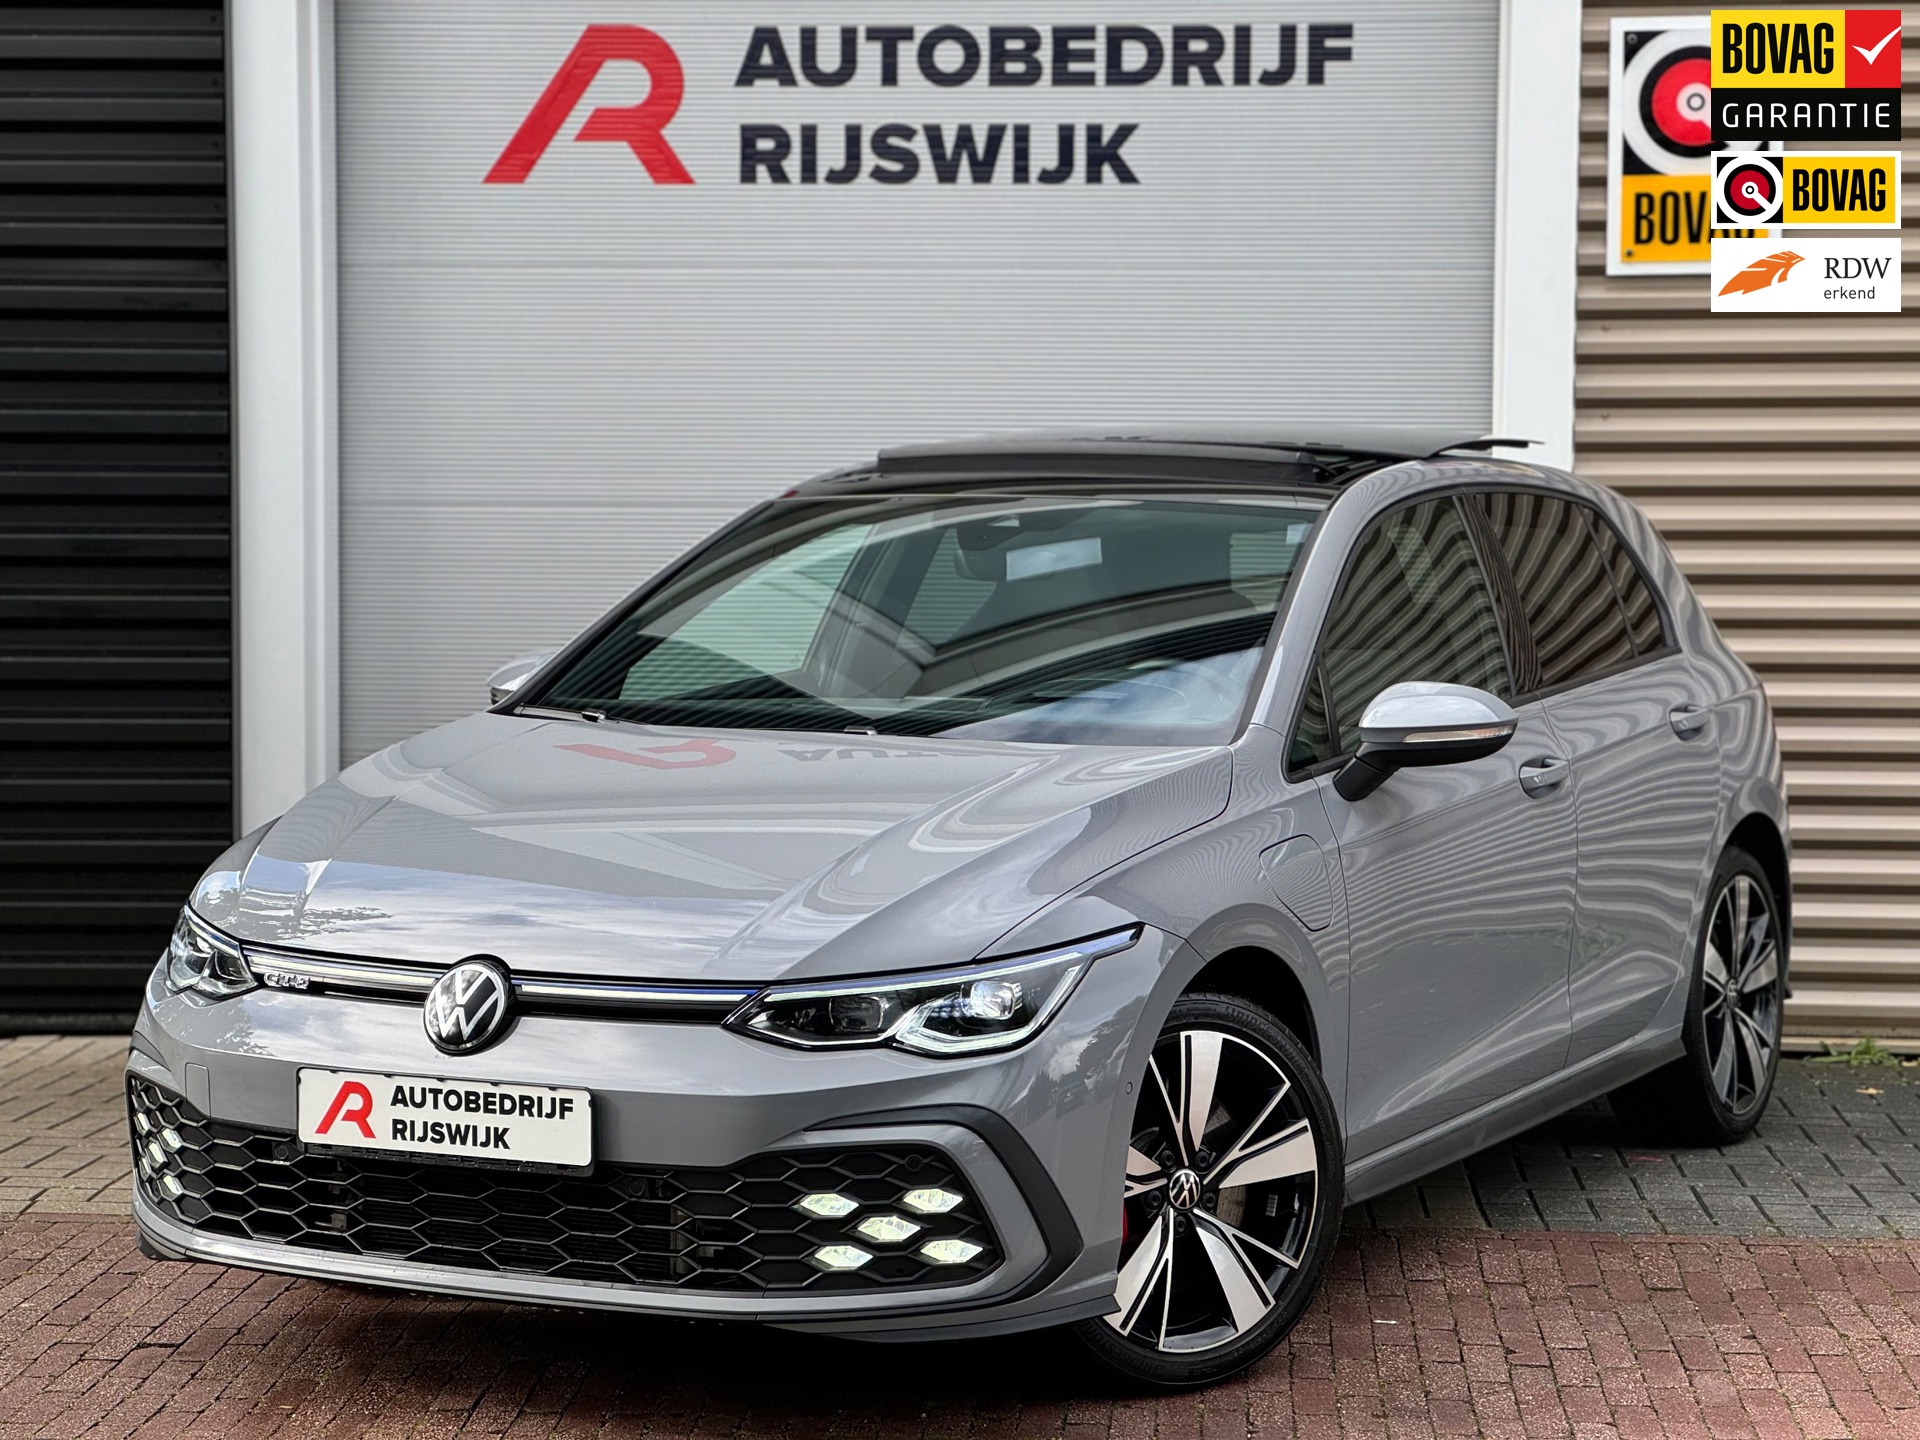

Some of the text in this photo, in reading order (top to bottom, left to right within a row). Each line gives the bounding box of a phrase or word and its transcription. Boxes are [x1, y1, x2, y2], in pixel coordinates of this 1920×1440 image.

[735, 24, 1353, 88] AUTOBEDRIJF
[740, 123, 1140, 185] RIJSWIJK
[1634, 190, 1754, 245] BOV
[390, 1085, 574, 1120] AUTOBEDRIJF
[391, 1118, 511, 1150] RIJSWIJK
